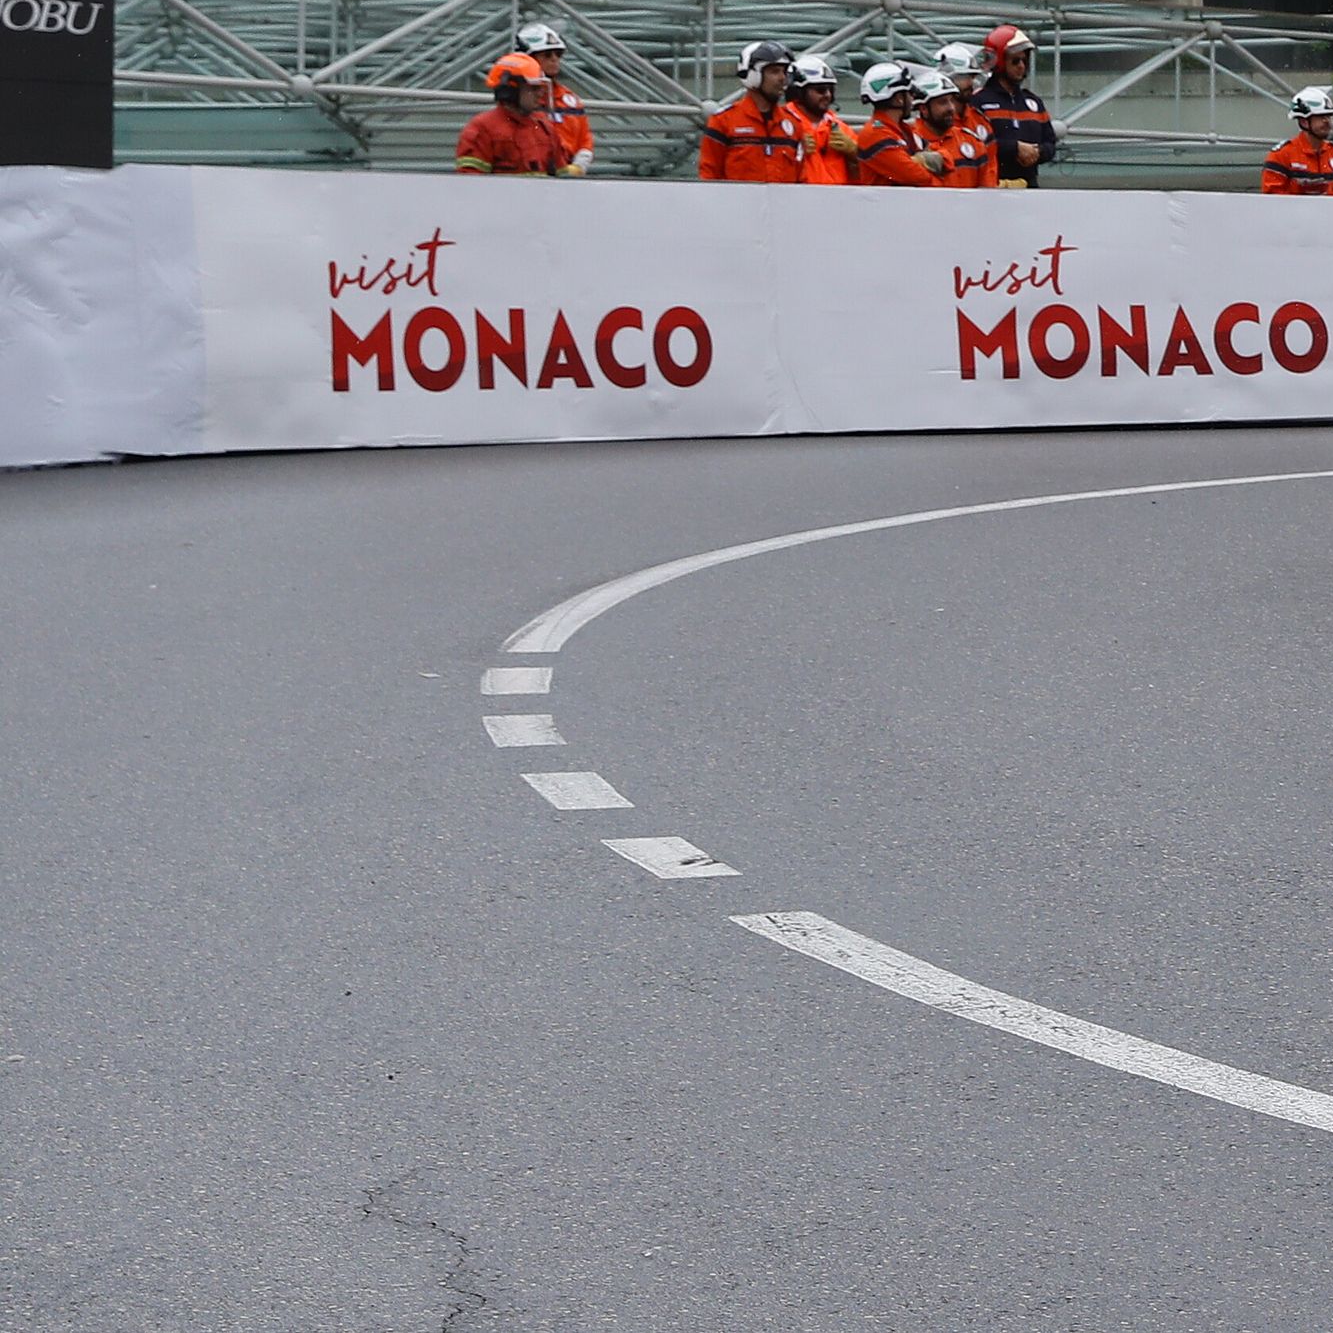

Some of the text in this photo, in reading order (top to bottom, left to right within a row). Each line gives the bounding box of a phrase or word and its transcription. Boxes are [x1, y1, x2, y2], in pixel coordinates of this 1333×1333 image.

[328, 226, 457, 298] visit
[953, 235, 1079, 299] visit
[331, 306, 713, 392] MONACO
[956, 301, 1329, 380] MONACO
